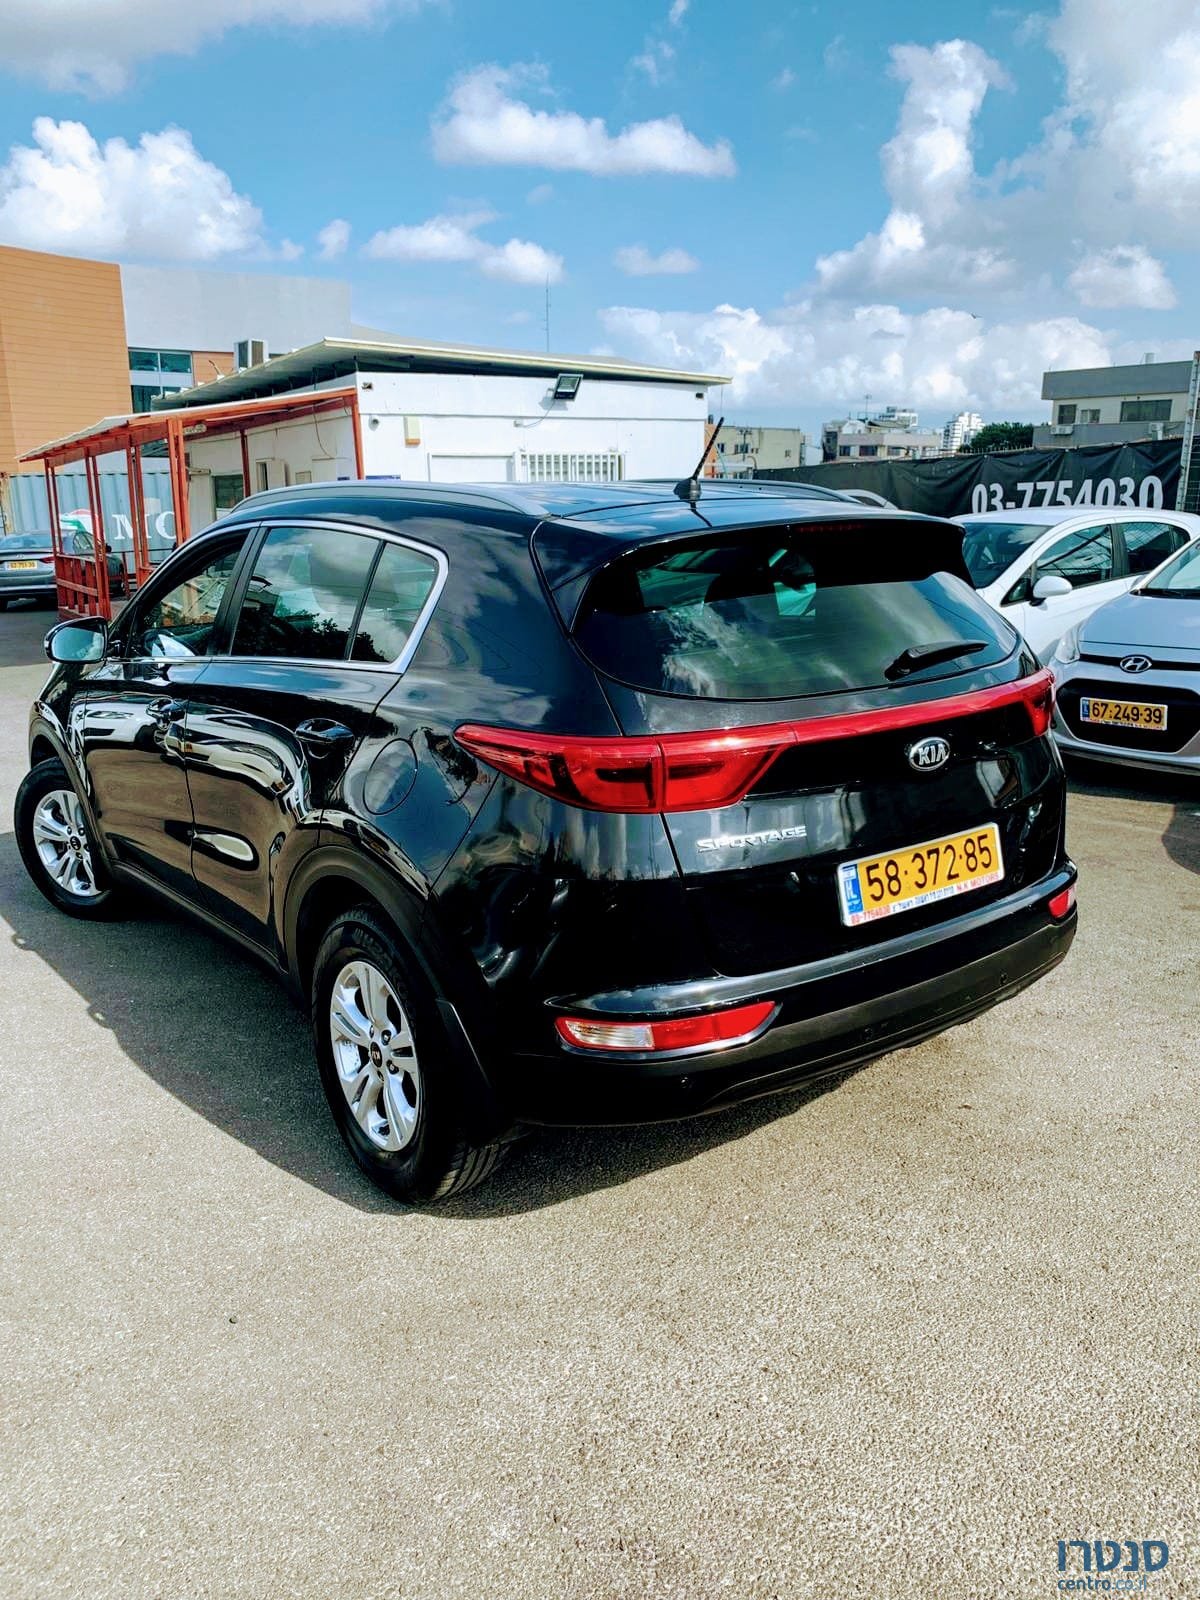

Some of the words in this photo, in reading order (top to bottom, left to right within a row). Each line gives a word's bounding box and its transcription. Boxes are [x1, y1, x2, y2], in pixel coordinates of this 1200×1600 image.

[971, 476, 1164, 513] 03-7754030
[918, 743, 947, 766] KIA
[696, 825, 808, 853] SPORTAGE
